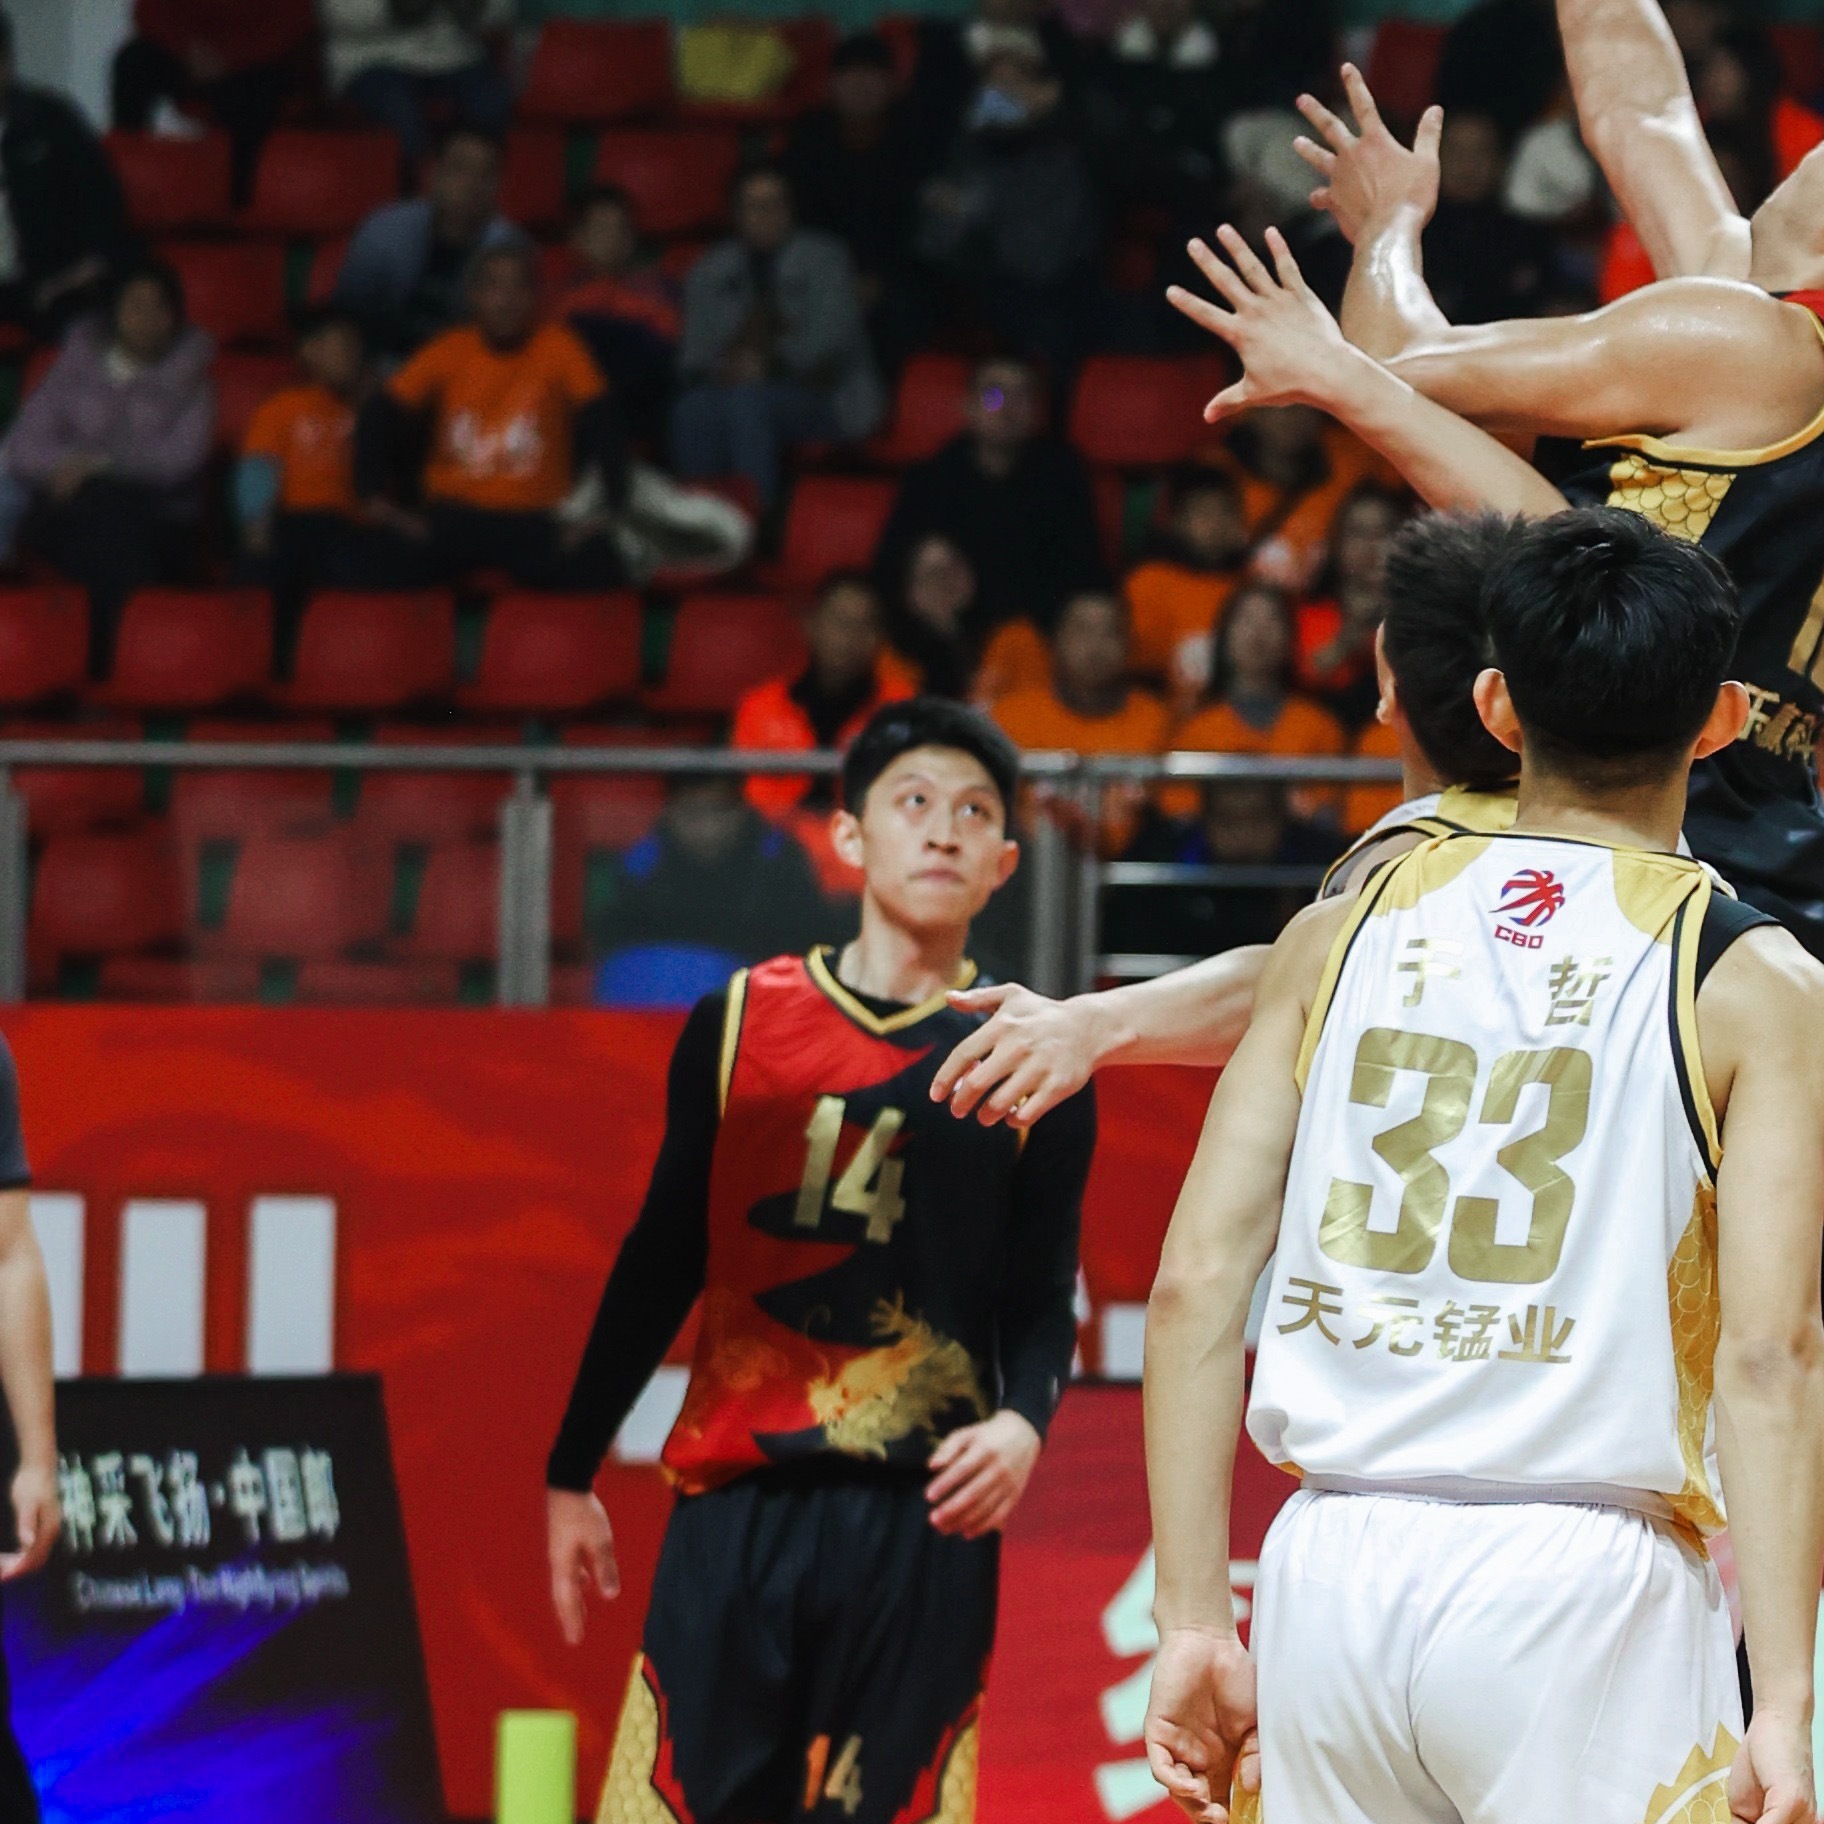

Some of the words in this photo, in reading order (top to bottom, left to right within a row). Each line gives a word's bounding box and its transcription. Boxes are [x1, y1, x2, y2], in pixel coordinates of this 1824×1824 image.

[1494, 925, 1544, 951] CBO
[794, 1094, 907, 1245] 14
[1317, 1025, 1594, 1286] 33
[1276, 1276, 1578, 1366] 天元锰业
[803, 1732, 864, 1817] 14
